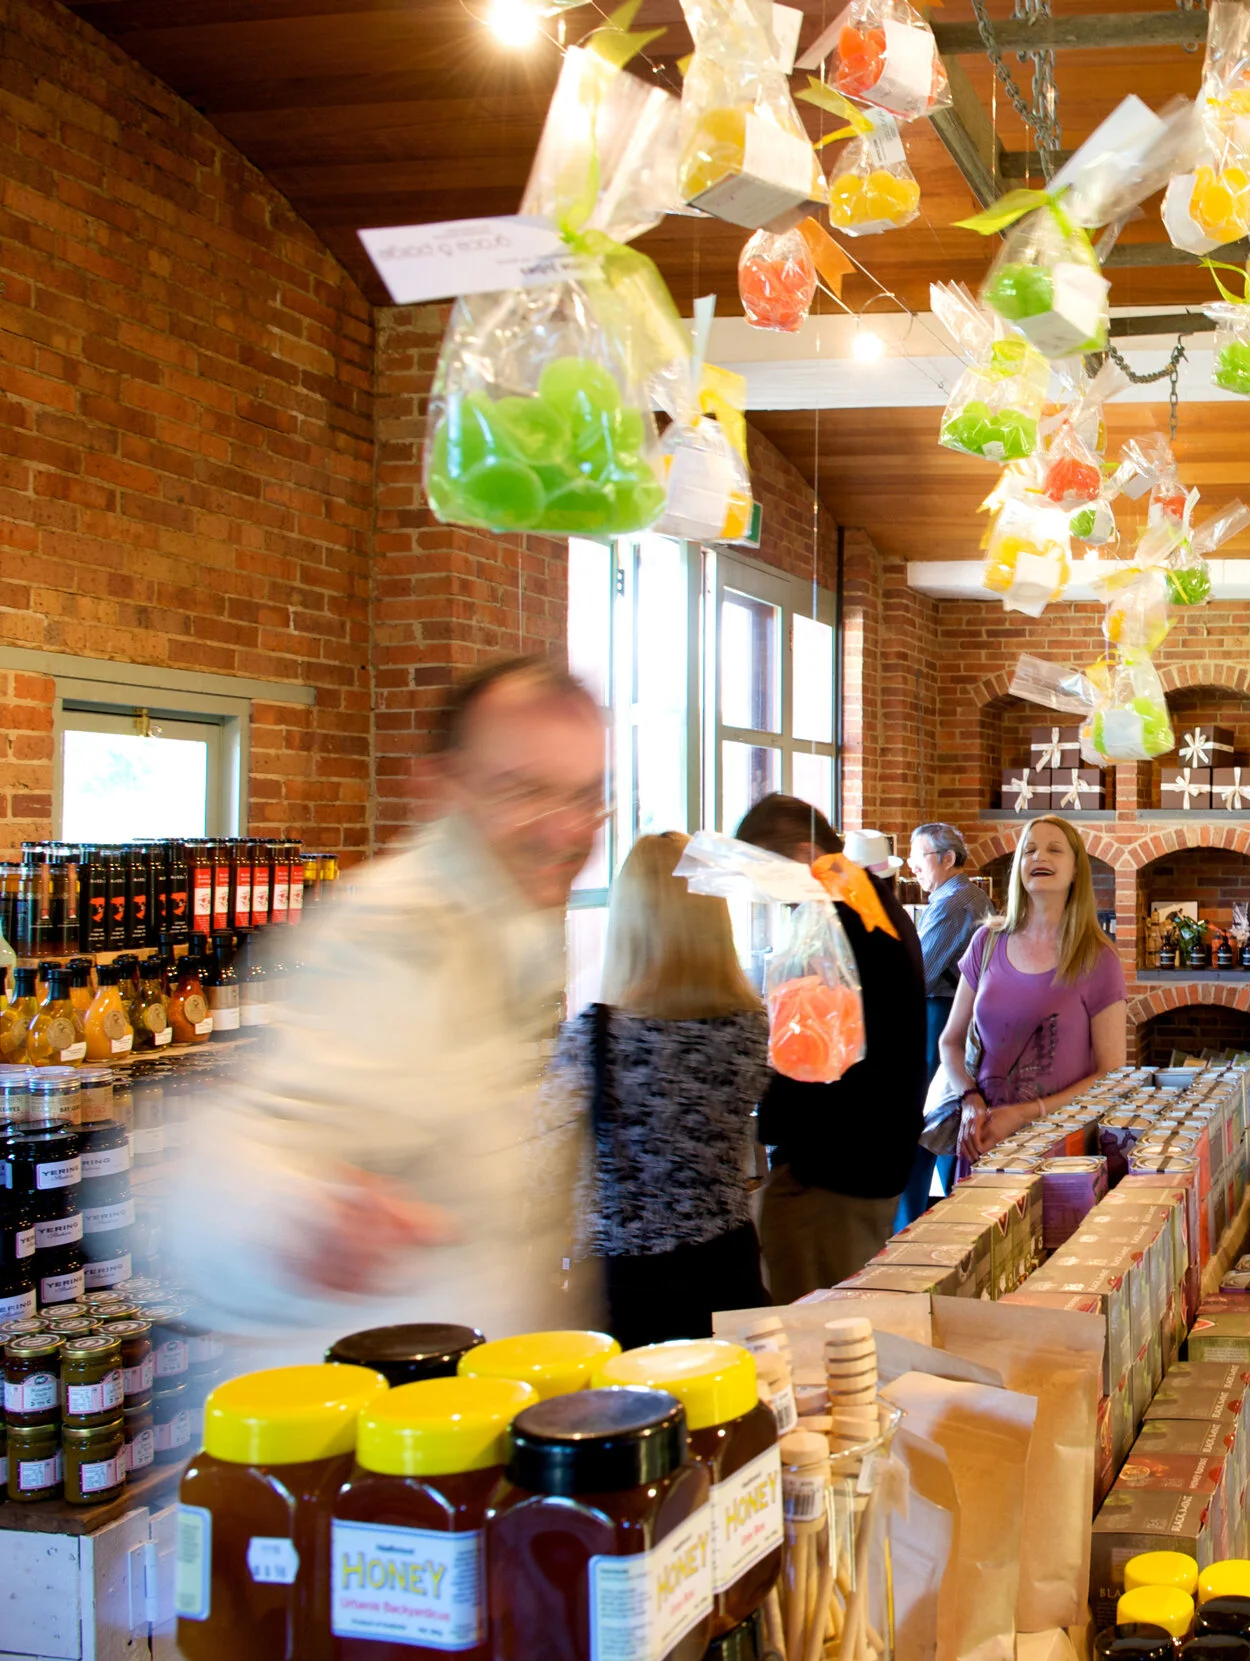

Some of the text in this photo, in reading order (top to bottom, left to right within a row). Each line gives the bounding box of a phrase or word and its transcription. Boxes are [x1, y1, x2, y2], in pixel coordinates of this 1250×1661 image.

[724, 1470, 778, 1541] HONEY
[341, 1552, 447, 1601] HONEY
[656, 1531, 710, 1613] HONEY
